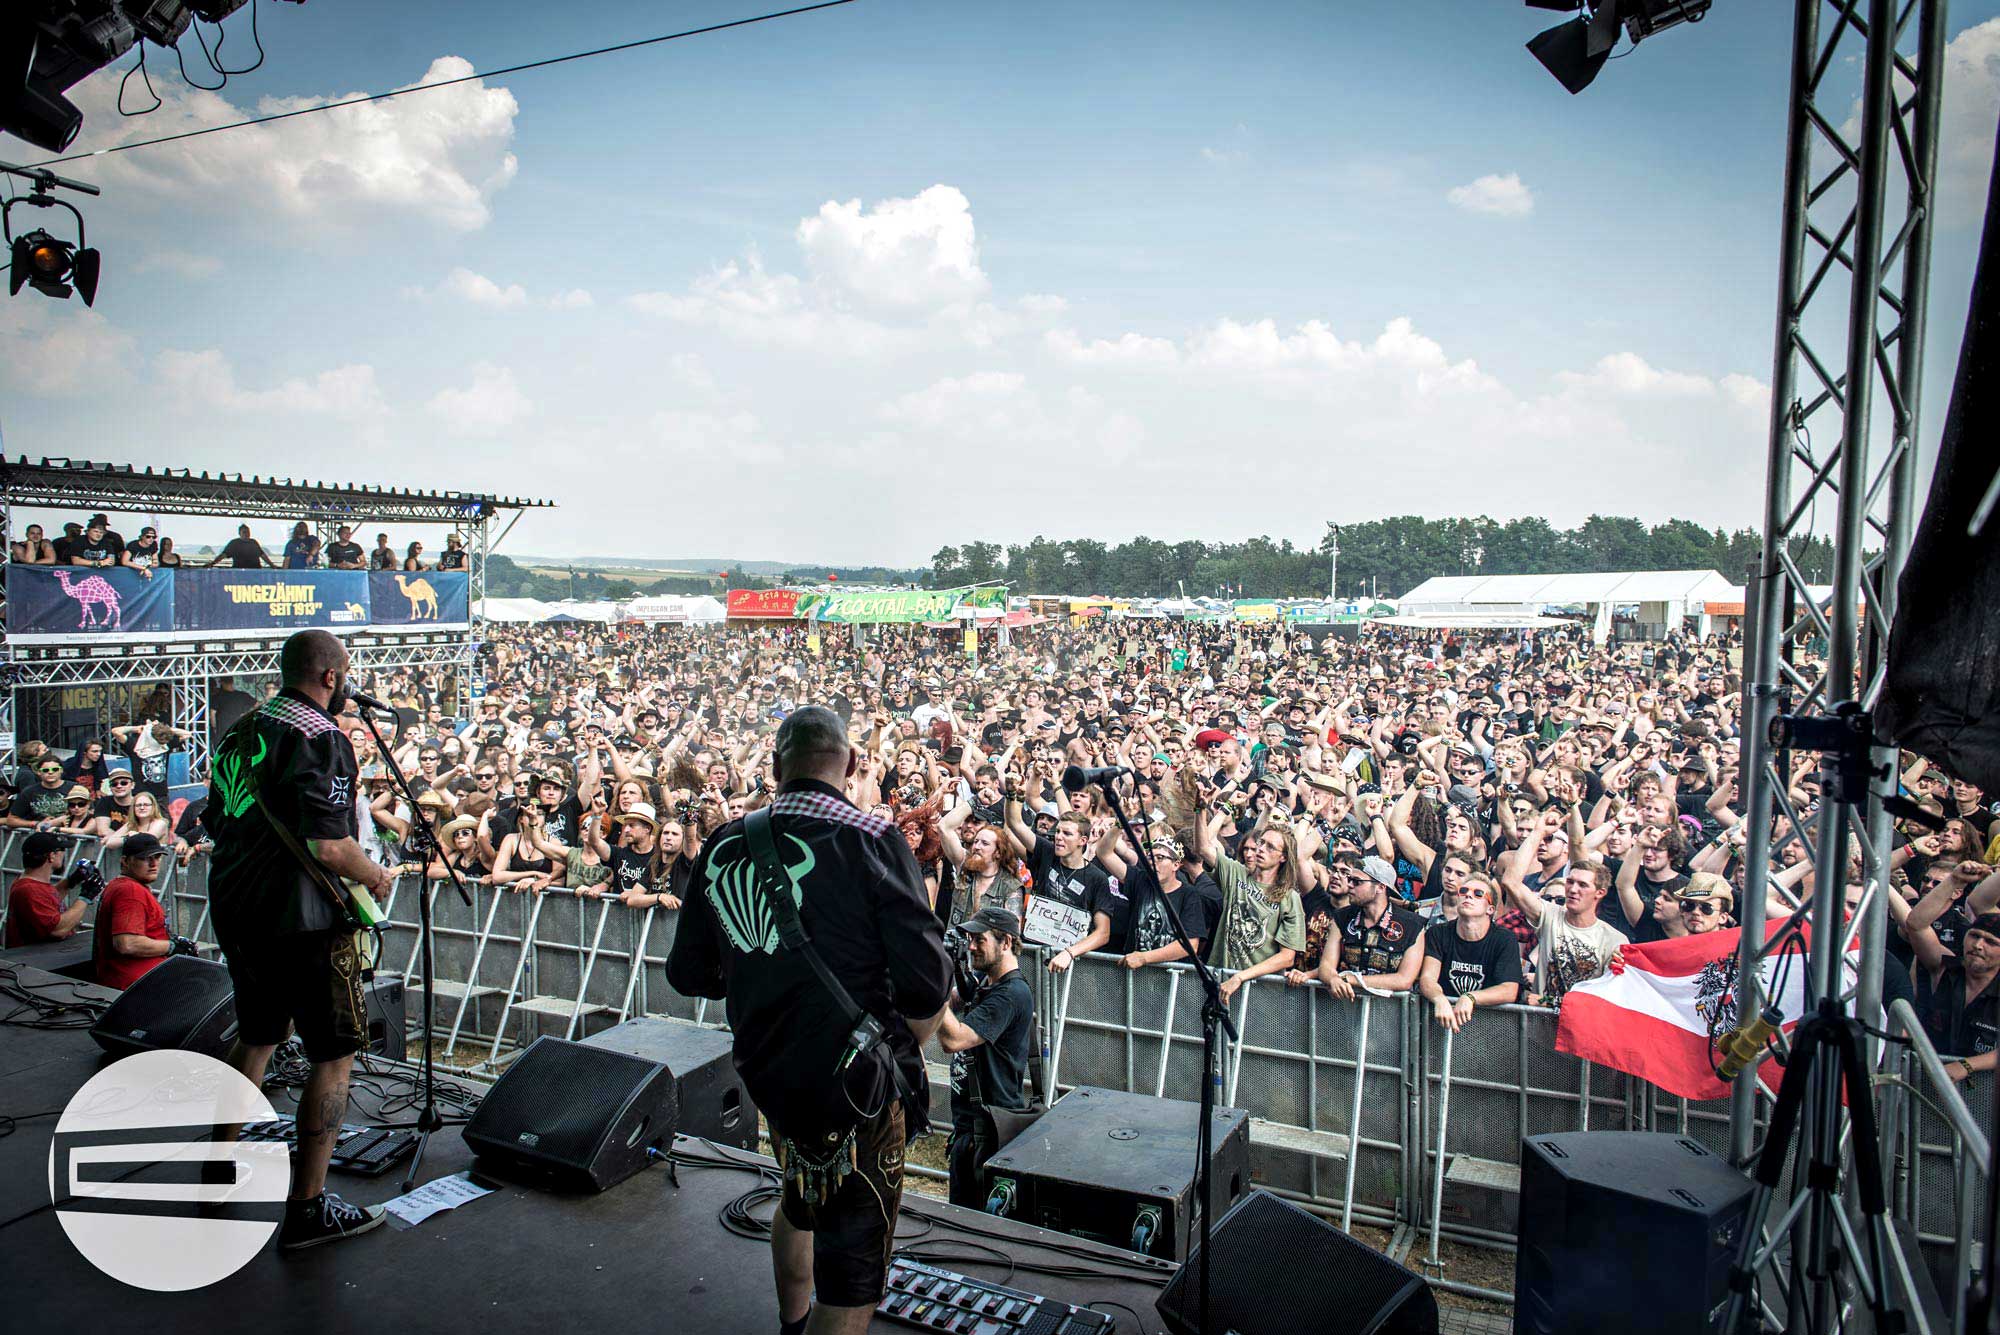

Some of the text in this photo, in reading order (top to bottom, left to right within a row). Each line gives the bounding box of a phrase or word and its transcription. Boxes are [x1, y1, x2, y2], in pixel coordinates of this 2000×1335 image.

[758, 591, 779, 602] ASIA
[269, 602, 292, 617] SEIT
[841, 596, 947, 616] COCKTAIL-BAR
[1030, 895, 1059, 922] Free
